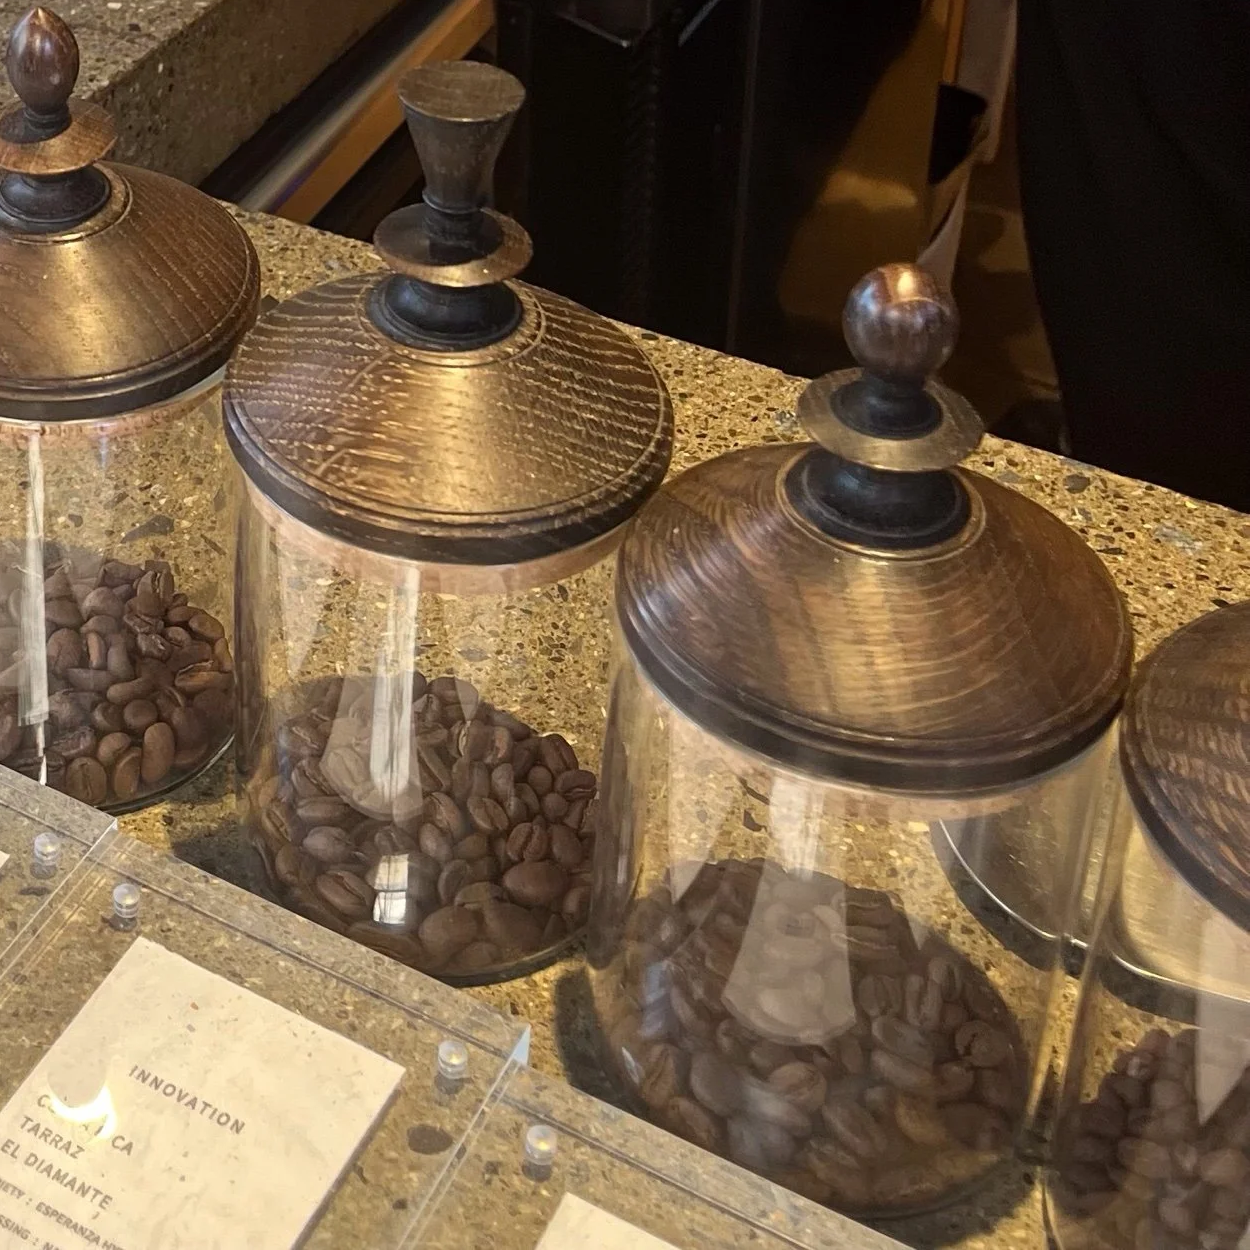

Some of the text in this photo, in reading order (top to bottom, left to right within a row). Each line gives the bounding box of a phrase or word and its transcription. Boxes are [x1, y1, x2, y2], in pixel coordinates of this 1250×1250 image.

[129, 1065, 246, 1135] INNOVATION
[20, 1115, 86, 1159] TARRAZ
[0, 1139, 113, 1211] EL DIAMANTE
[35, 1202, 101, 1246] ESPERANZA
